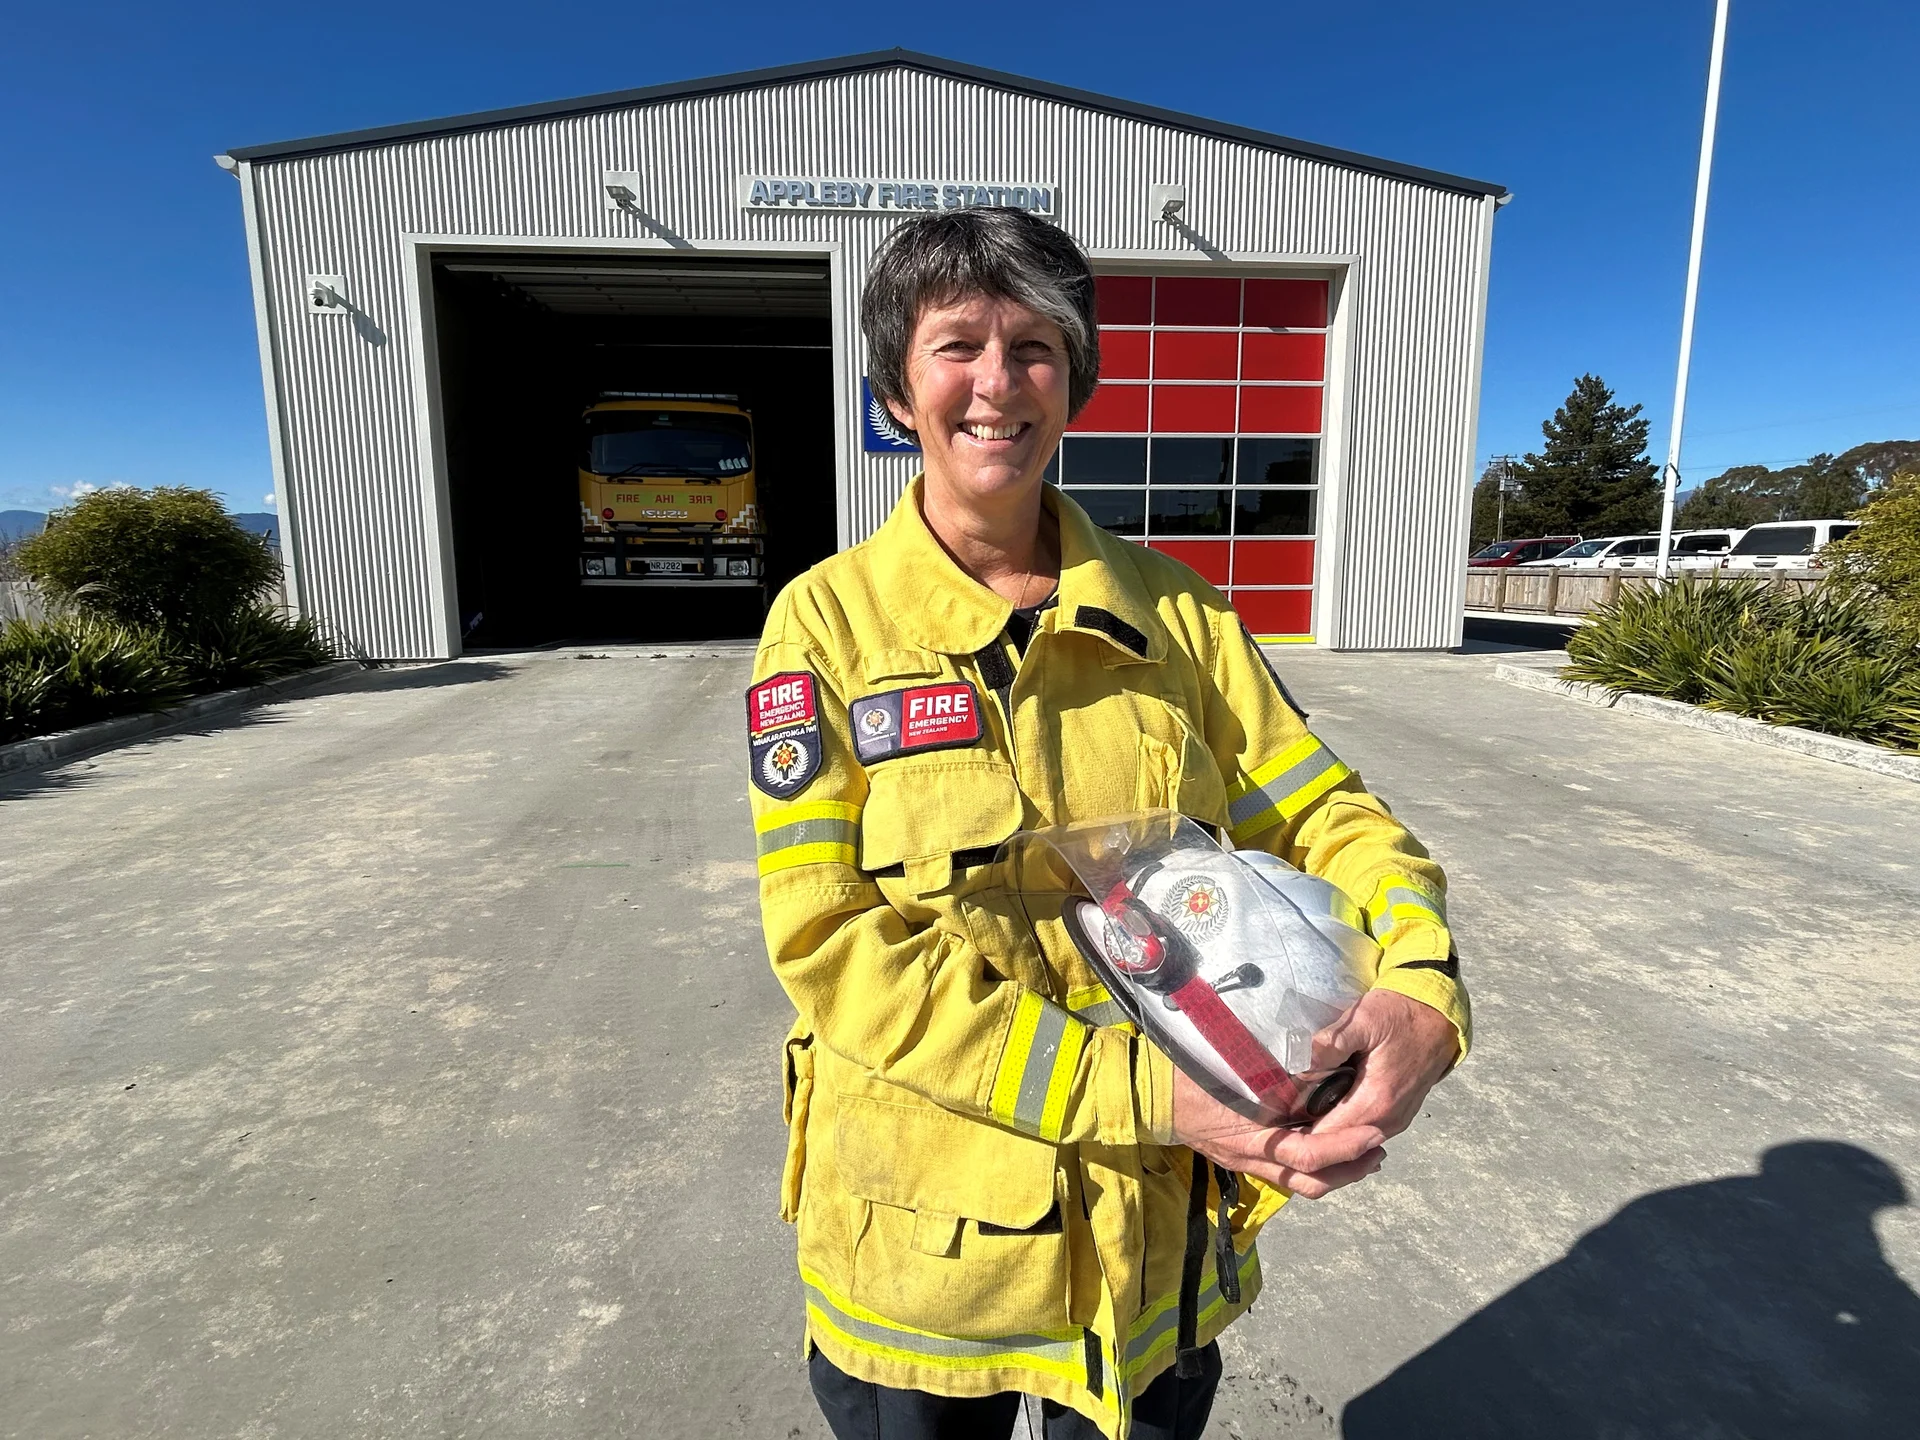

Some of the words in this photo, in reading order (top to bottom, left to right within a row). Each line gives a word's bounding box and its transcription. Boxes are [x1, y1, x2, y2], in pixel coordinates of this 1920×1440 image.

[750, 180, 872, 207] APPLEBY
[878, 183, 938, 208] FIRE
[943, 185, 1051, 212] STATION
[616, 494, 640, 503] FIRE
[655, 495, 674, 504] AHI
[641, 509, 688, 519] ISUZU
[758, 680, 805, 711] FIRE
[760, 701, 805, 719] EMERGENCY
[909, 693, 969, 719] FIRE
[760, 717, 776, 728] NEW
[776, 710, 806, 723] ZEALAND
[908, 714, 969, 730] EMERGENCY
[753, 728, 806, 746] WHAKARATONGA
[805, 725, 817, 734] IWI
